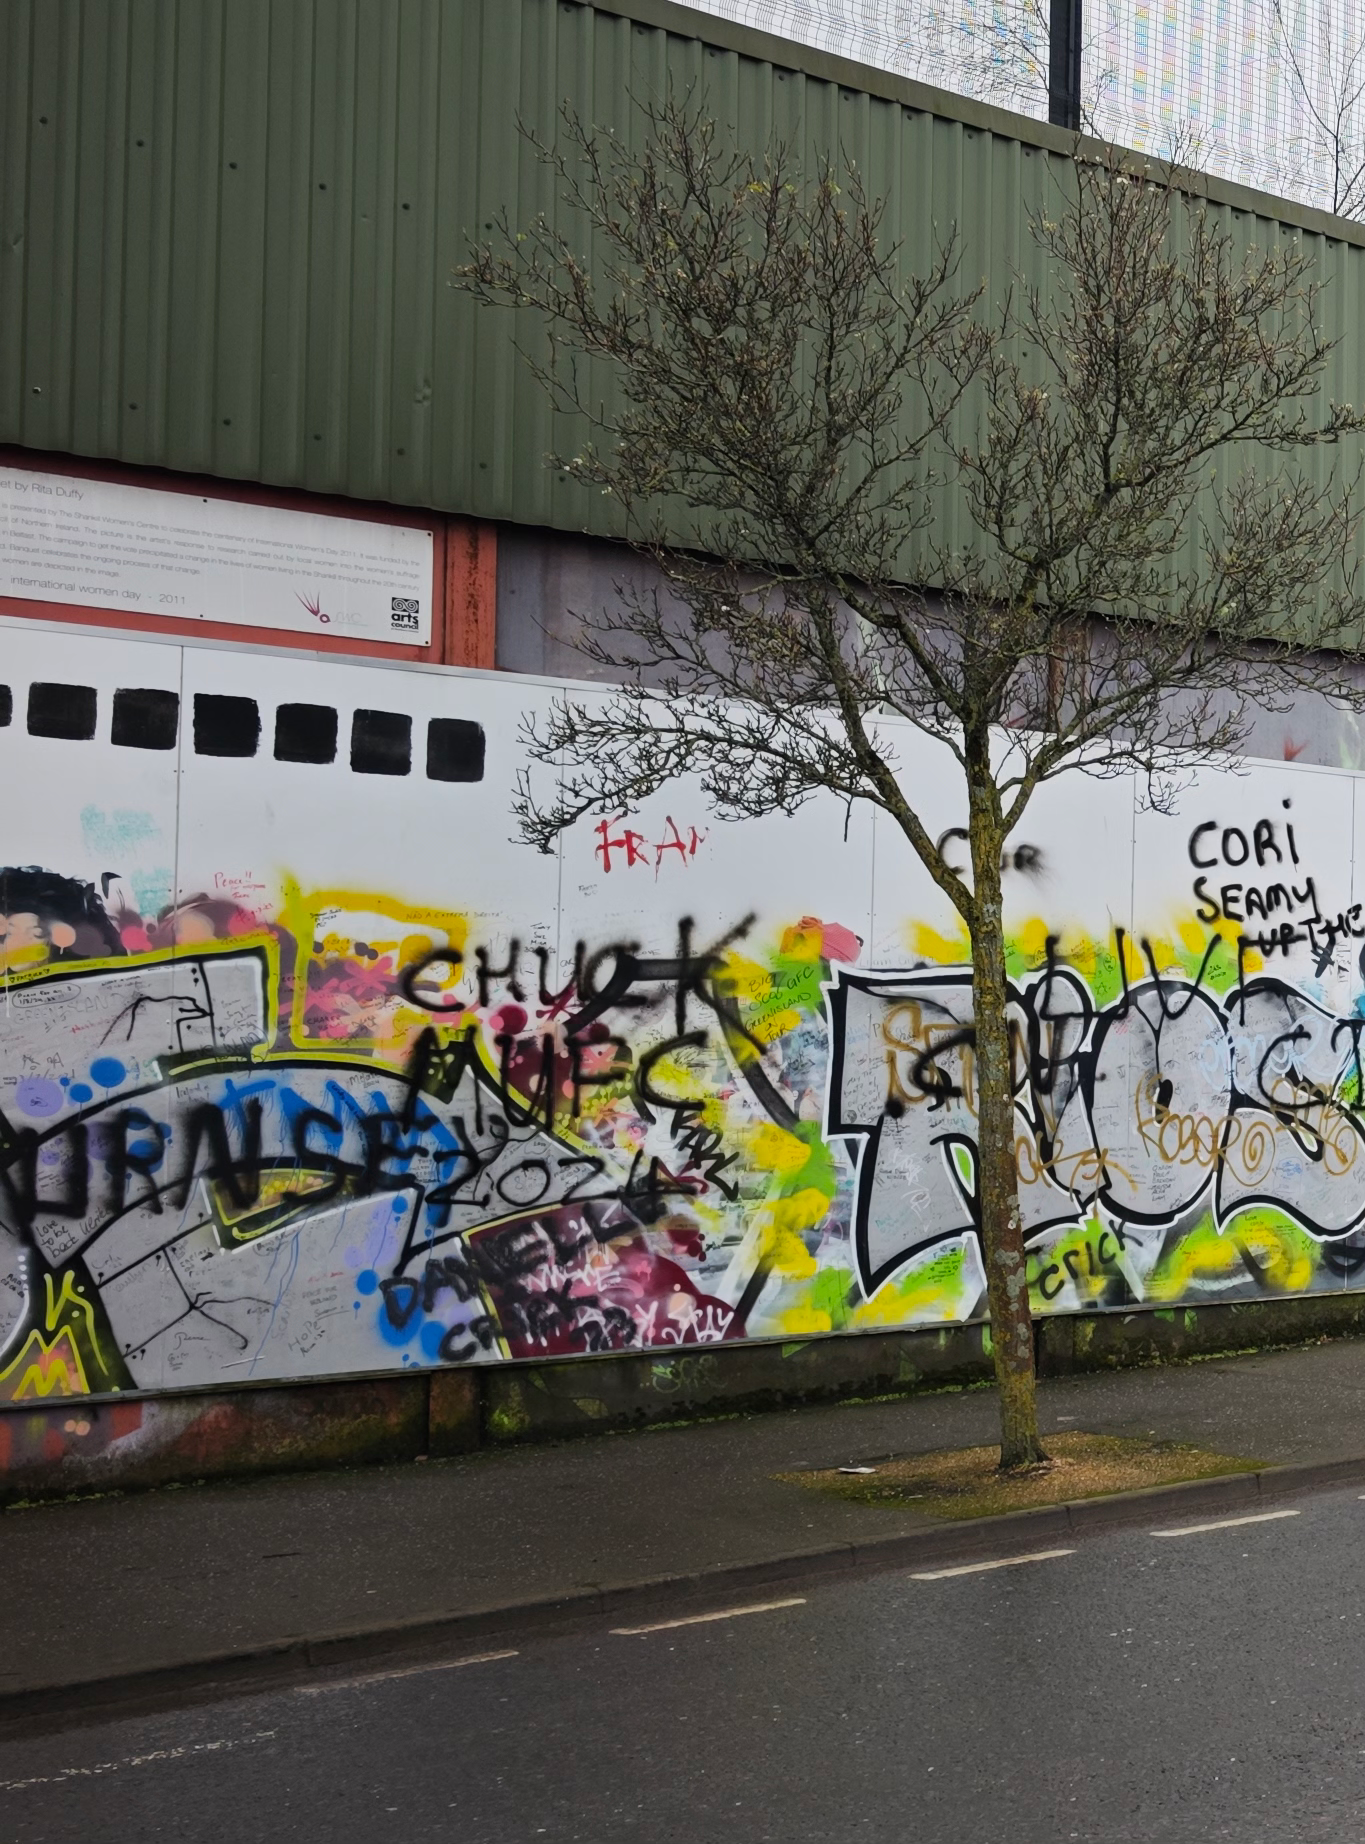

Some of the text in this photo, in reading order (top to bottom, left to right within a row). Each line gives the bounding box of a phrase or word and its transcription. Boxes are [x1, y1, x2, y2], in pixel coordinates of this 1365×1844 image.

[14, 481, 28, 492] by
[31, 482, 52, 494] Rita
[55, 486, 83, 500] Duffy
[9, 504, 46, 514] presented
[58, 509, 72, 517] The
[73, 511, 100, 521] Shankill
[101, 516, 134, 526] Women's
[136, 520, 159, 529] Centre
[255, 538, 293, 548] International
[294, 543, 324, 553] Women's
[325, 547, 338, 555] Day
[379, 555, 400, 563] funded
[21, 518, 52, 527] Northern
[84, 526, 97, 534] The
[100, 530, 123, 538] picture
[173, 540, 204, 549] response
[216, 546, 245, 554] research
[1, 557, 29, 565] women
[43, 562, 75, 571] depicted
[9, 543, 39, 553] Banquet
[41, 549, 78, 558] celebrates
[92, 555, 121, 565] ongoing
[122, 559, 150, 568] process
[38, 533, 51, 541] The
[53, 537, 87, 547] campaign
[184, 554, 209, 563] change
[277, 566, 293, 575] living
[313, 571, 336, 579] Shankill
[337, 575, 370, 584] throughout
[10, 577, 184, 604] international women day 2011
[391, 611, 418, 624] arts
[391, 622, 418, 630] council
[1188, 798, 1300, 870] CORI
[1193, 875, 1322, 924] SEAMY
[744, 992, 812, 1032] GREENISLAND
[763, 1023, 792, 1043] TOUR
